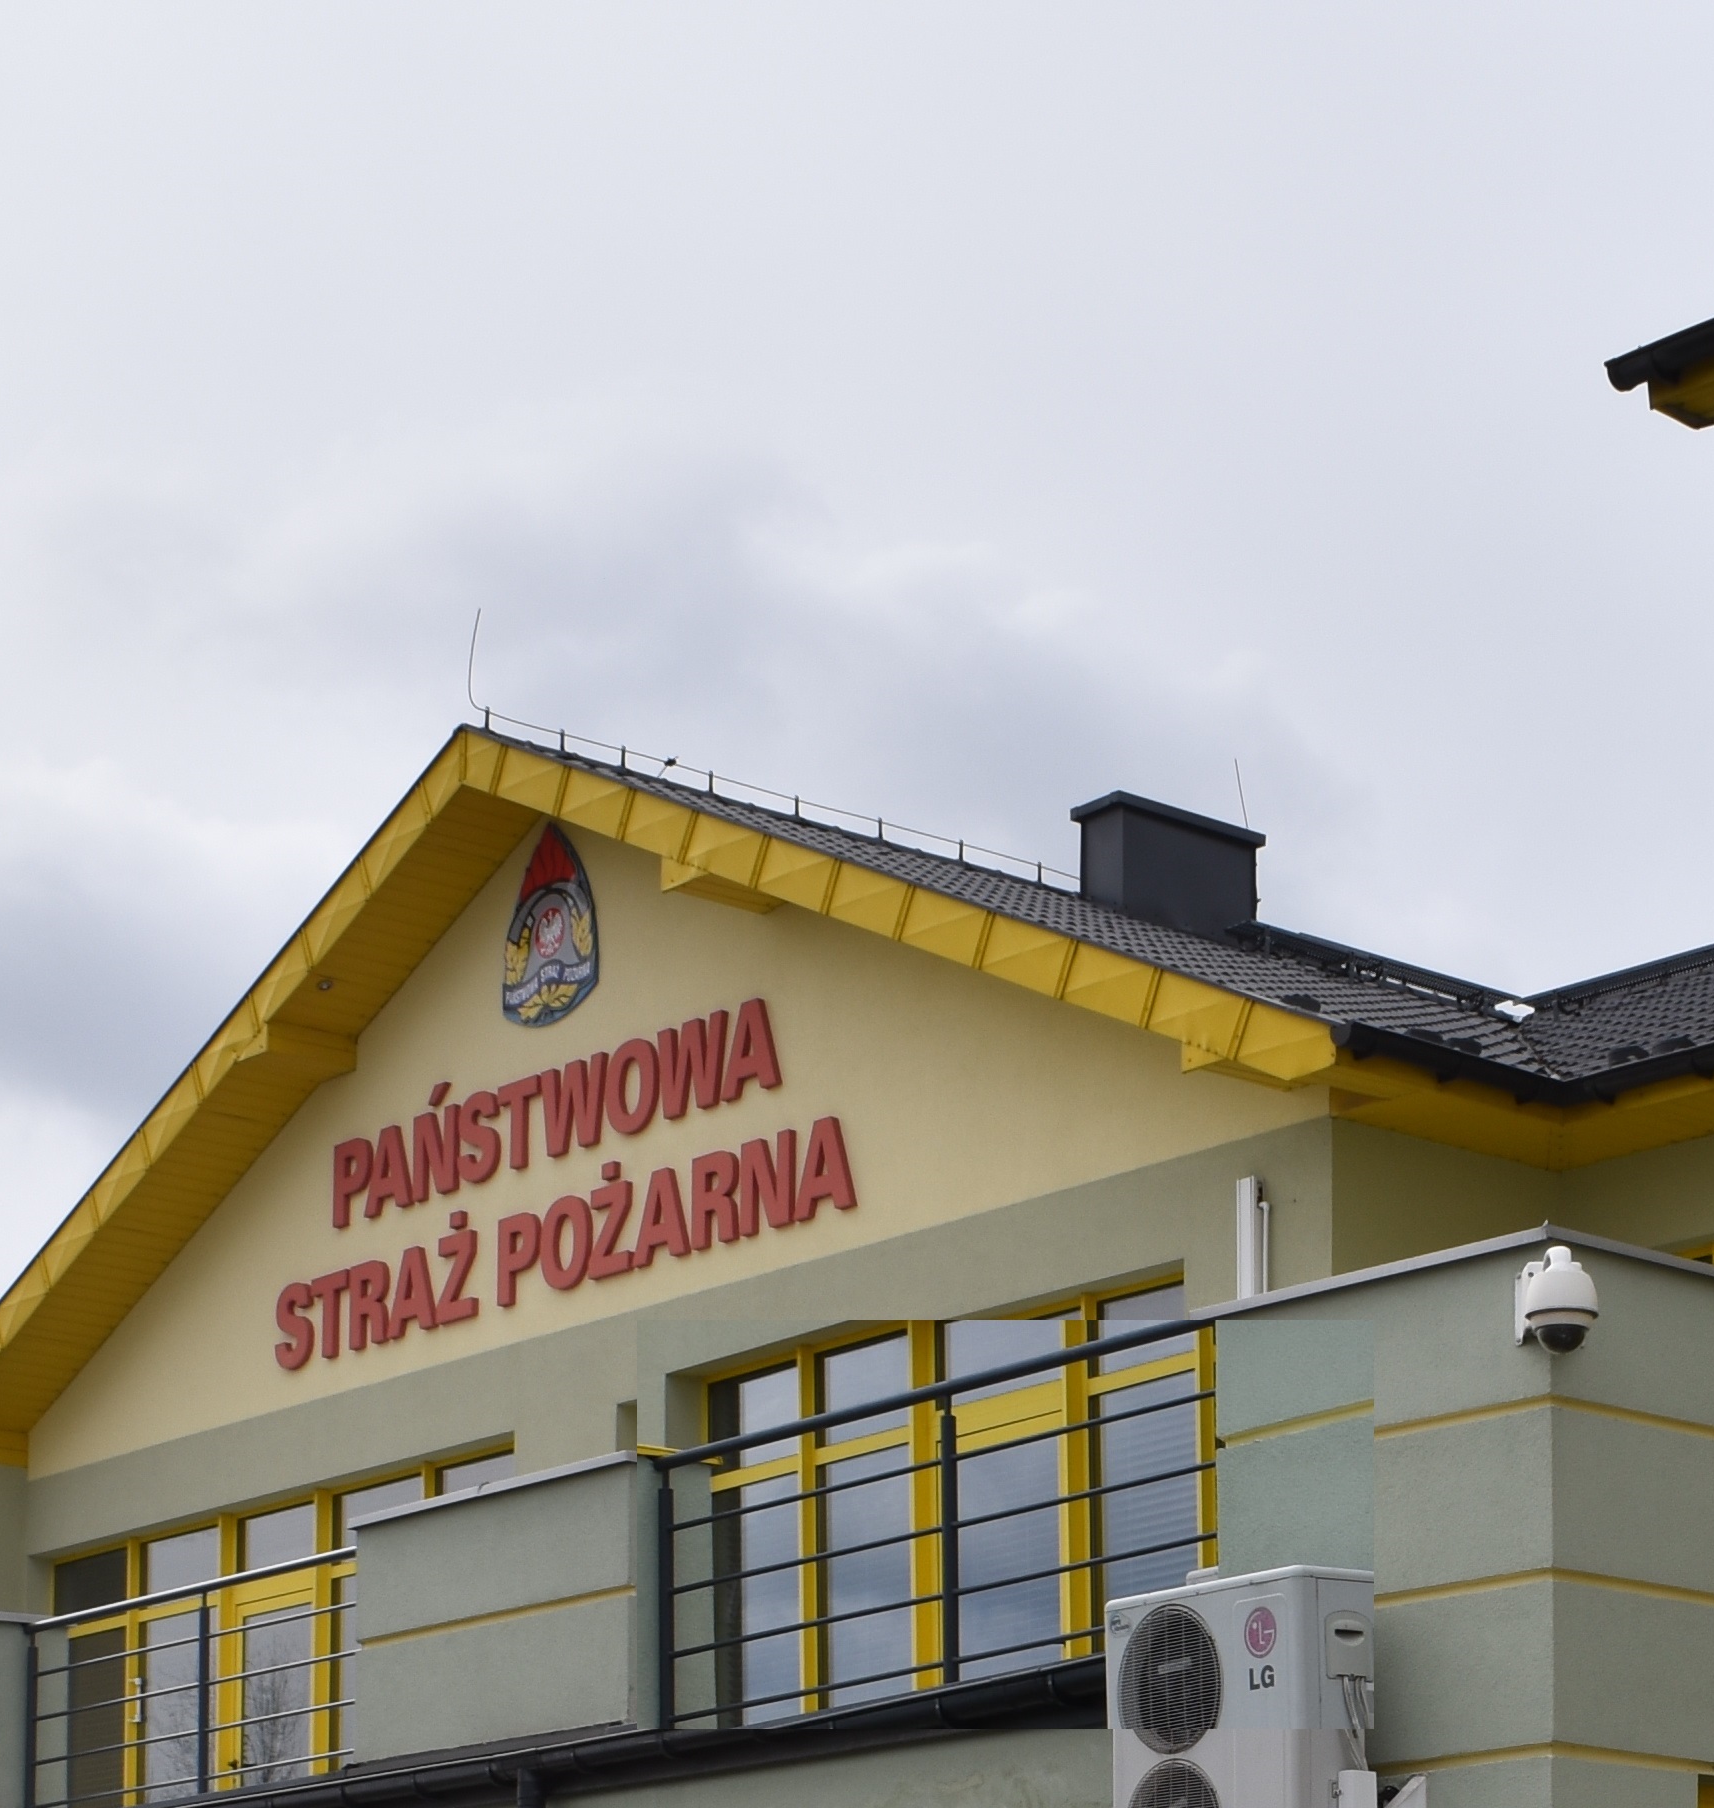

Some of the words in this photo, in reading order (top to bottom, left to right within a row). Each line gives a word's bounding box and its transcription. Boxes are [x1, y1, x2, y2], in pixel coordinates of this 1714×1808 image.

[332, 998, 782, 1229] PAŃSTWOWA
[275, 1210, 478, 1370] STRAŻ
[497, 1116, 858, 1308] POŻARNA
[1248, 1664, 1275, 1691] LG
